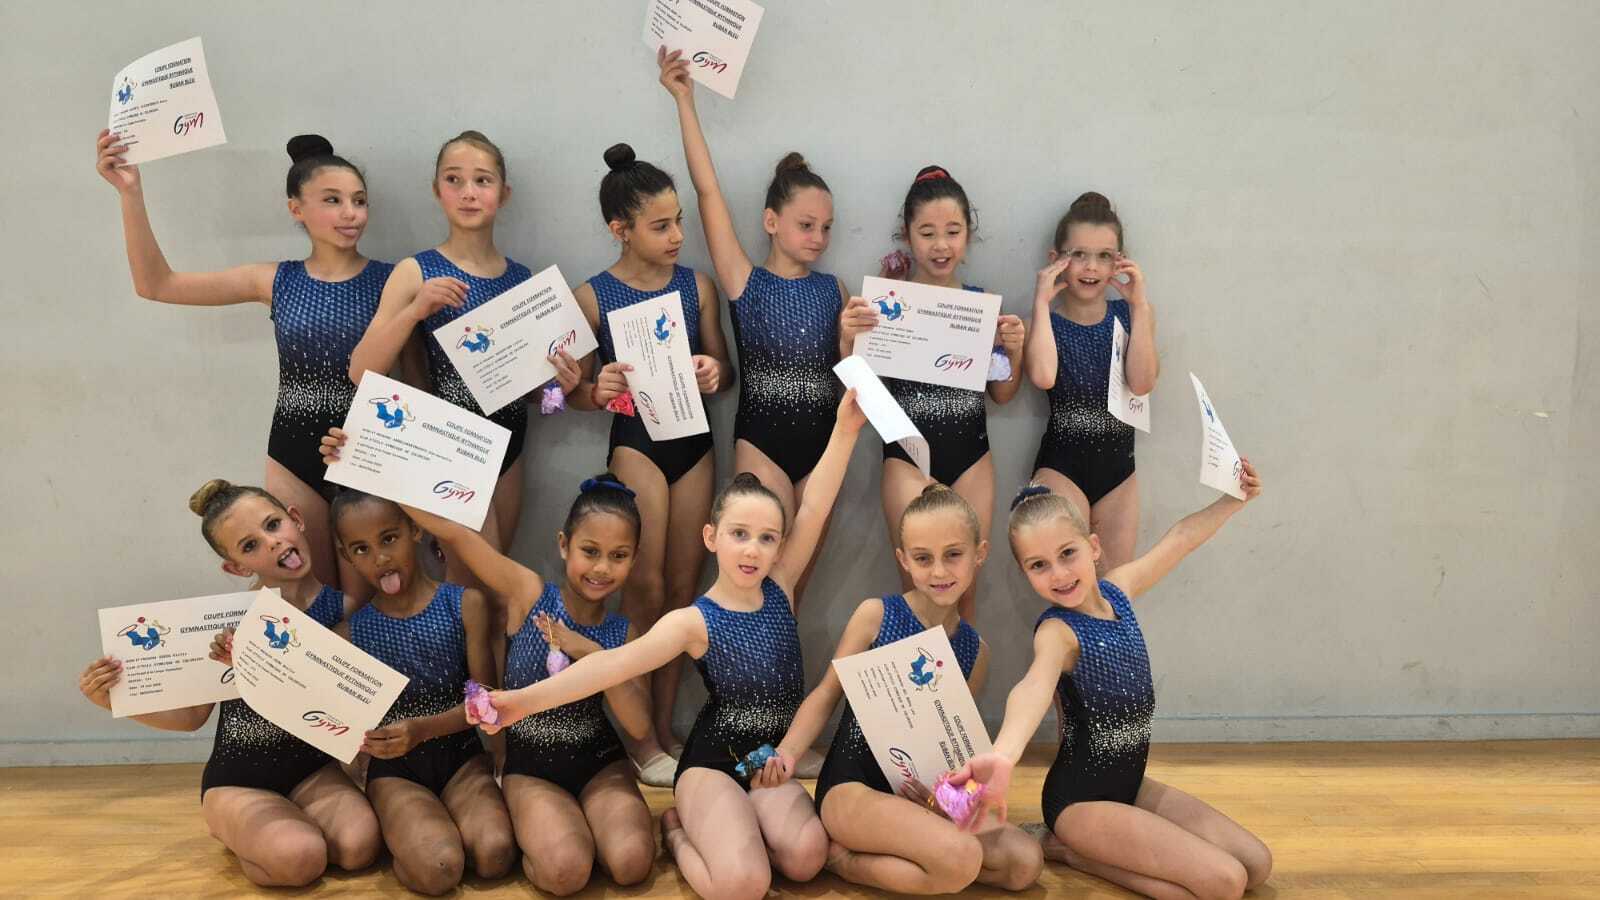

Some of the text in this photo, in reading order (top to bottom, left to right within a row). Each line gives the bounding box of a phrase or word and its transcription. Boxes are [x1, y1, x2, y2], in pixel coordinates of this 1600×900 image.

[693, 52, 727, 73] Gym
[174, 112, 204, 136] Gym
[934, 354, 974, 372] Gym
[432, 480, 476, 504] Gym
[302, 710, 349, 736] Gym
